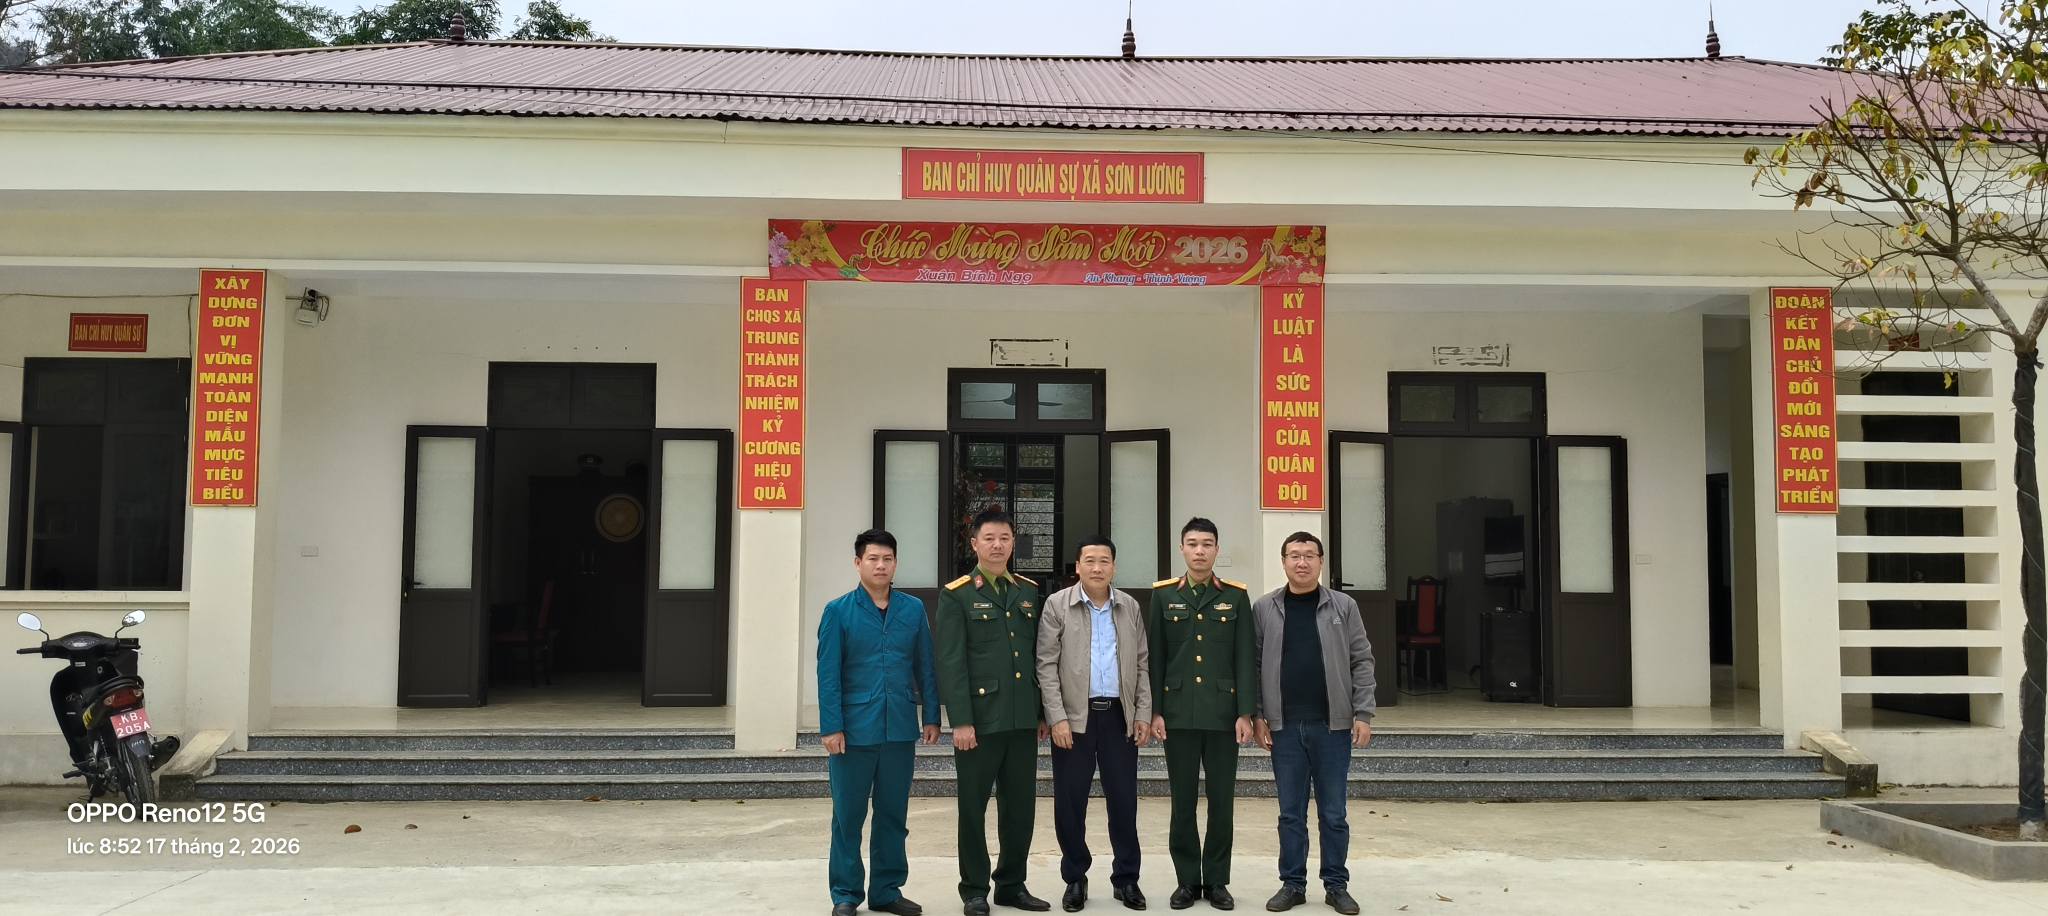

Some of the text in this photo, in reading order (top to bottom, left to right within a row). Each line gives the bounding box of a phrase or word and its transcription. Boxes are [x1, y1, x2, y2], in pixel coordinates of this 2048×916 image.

[922, 152, 1185, 200] BAN CHỈ HUY QUÂN SỰ XÃ SƠN LƯƠNG
[1173, 236, 1249, 264] 2026
[214, 276, 250, 290] XÂY
[915, 268, 1033, 285] Xuân Bính Ngọ
[755, 288, 789, 302] BAN
[1282, 288, 1305, 309] KỶ
[208, 296, 258, 312] DỰNG
[212, 315, 250, 328] ĐƠN
[746, 307, 802, 324] CHQS XÃ
[1785, 314, 1818, 330] KẾT
[1273, 316, 1315, 339] LUẬT
[220, 335, 237, 349] VỊ
[745, 331, 800, 345] TRUNG
[1783, 335, 1821, 350] DÂN
[205, 352, 253, 365] VỮNG
[745, 351, 800, 366] THÀNH
[1283, 344, 1304, 363] LÀ
[1786, 356, 1822, 373] CHỦ
[200, 372, 254, 387] MẠNH
[745, 373, 798, 388] TRÁCH
[1276, 371, 1311, 391] SỨC
[1788, 377, 1819, 395] ĐỔI
[204, 389, 251, 403] TOÀN
[745, 394, 799, 413] NHIỆM
[206, 408, 248, 425] DIỆN
[1267, 400, 1320, 421] MẠNH
[1787, 401, 1822, 416] MỚI
[762, 415, 784, 433] KỶ
[1780, 422, 1830, 438] SÁNG
[205, 426, 246, 442] MẪU
[1276, 424, 1311, 446] CỦA
[205, 448, 245, 464] MỰC
[745, 441, 801, 455] CƯƠNG
[1789, 447, 1824, 464] TẠO
[1267, 453, 1315, 473] QUÂN
[205, 467, 243, 481] TIÊU
[754, 463, 792, 480] HIỆU
[1783, 466, 1830, 482] PHÁT
[203, 484, 244, 500] BIỂU
[753, 482, 787, 500] QUẢ
[1278, 481, 1308, 504] ĐỘI
[1781, 485, 1834, 504] TRIỂN
[116, 721, 150, 737] 205A
